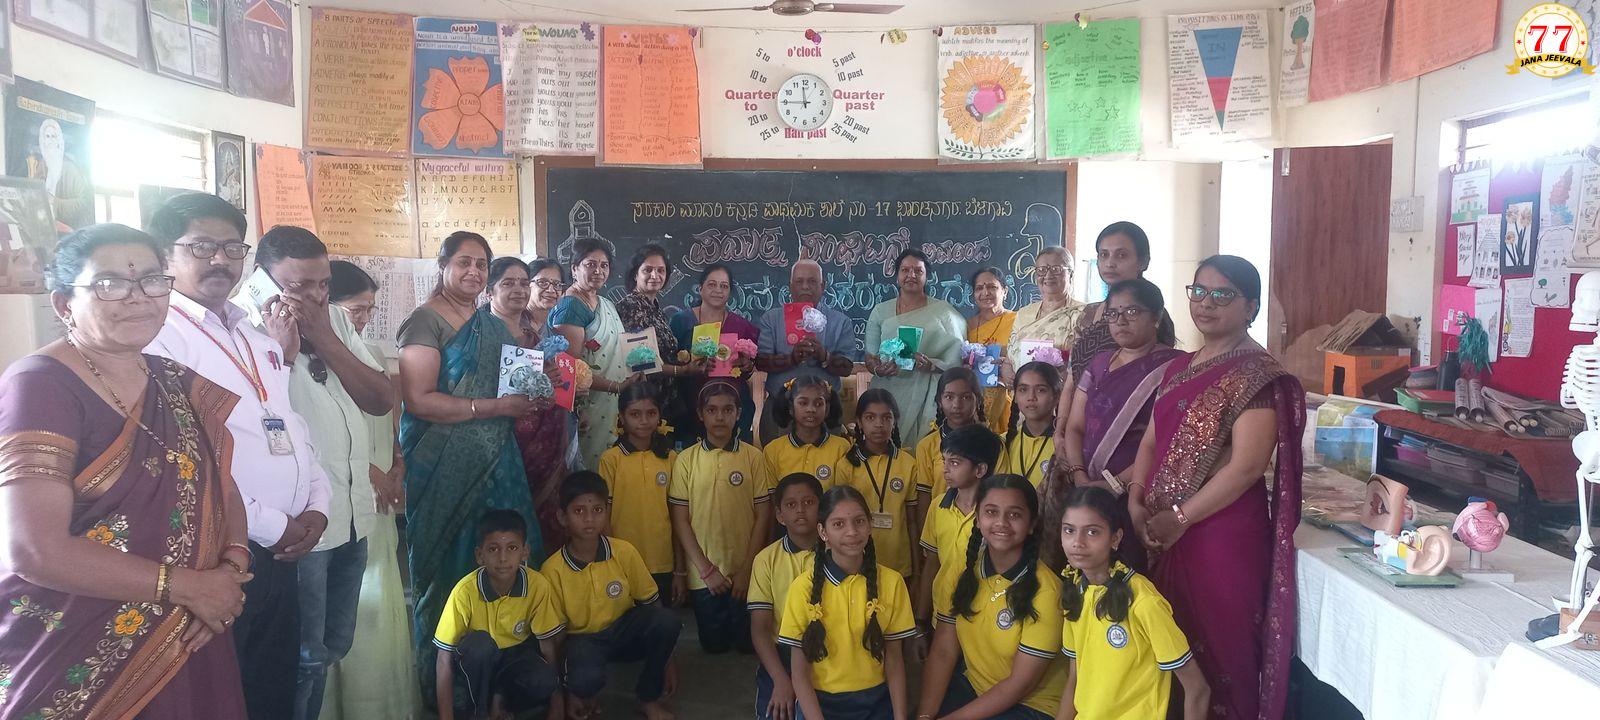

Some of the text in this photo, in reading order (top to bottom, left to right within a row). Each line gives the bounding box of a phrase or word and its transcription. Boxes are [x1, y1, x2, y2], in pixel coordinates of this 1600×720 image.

[451, 25, 478, 33] NOUN
[953, 26, 998, 36] ADVERB
[756, 48, 770, 62] 5 to
[787, 46, 822, 57] o'clock
[832, 51, 856, 68] 5 past
[537, 67, 555, 76] mine
[558, 70, 571, 79] my
[750, 69, 767, 84] 10 to
[837, 68, 864, 82] 10 past
[724, 89, 778, 100] Quarter
[833, 89, 885, 100] Quarter
[538, 107, 549, 116] his
[744, 101, 758, 111] to
[845, 101, 875, 112] past
[747, 112, 768, 127] 20 to
[843, 115, 871, 135] 20 past
[759, 126, 780, 141] 25 to
[807, 127, 827, 140] past
[831, 122, 858, 144] 25 past
[421, 162, 435, 175] My
[435, 163, 470, 176] graceful
[474, 163, 504, 174] writing
